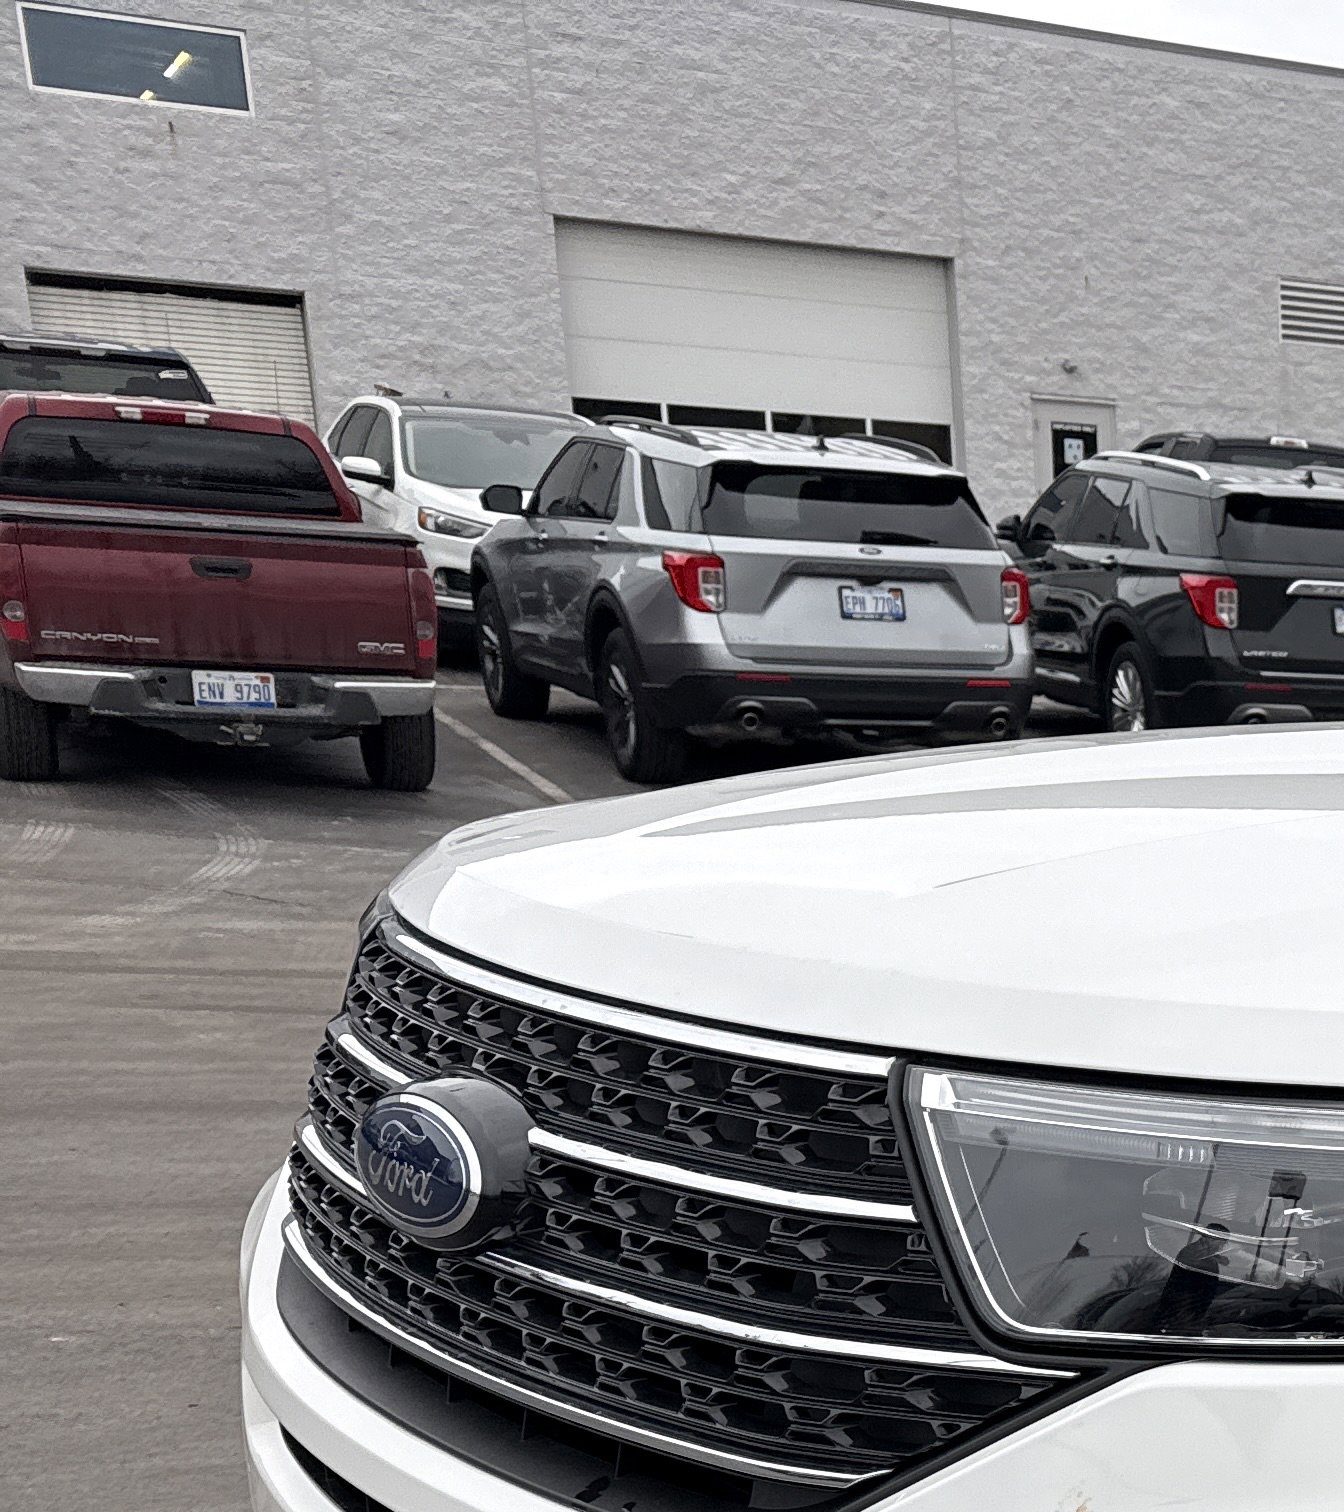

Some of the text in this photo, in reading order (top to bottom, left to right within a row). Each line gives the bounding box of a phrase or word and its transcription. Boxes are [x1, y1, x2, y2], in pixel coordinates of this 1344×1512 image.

[844, 595, 866, 611] EPH
[40, 630, 133, 643] CANYON
[357, 641, 406, 655] GMC
[198, 682, 271, 701] ENV 9790
[368, 1119, 439, 1207] Ford
